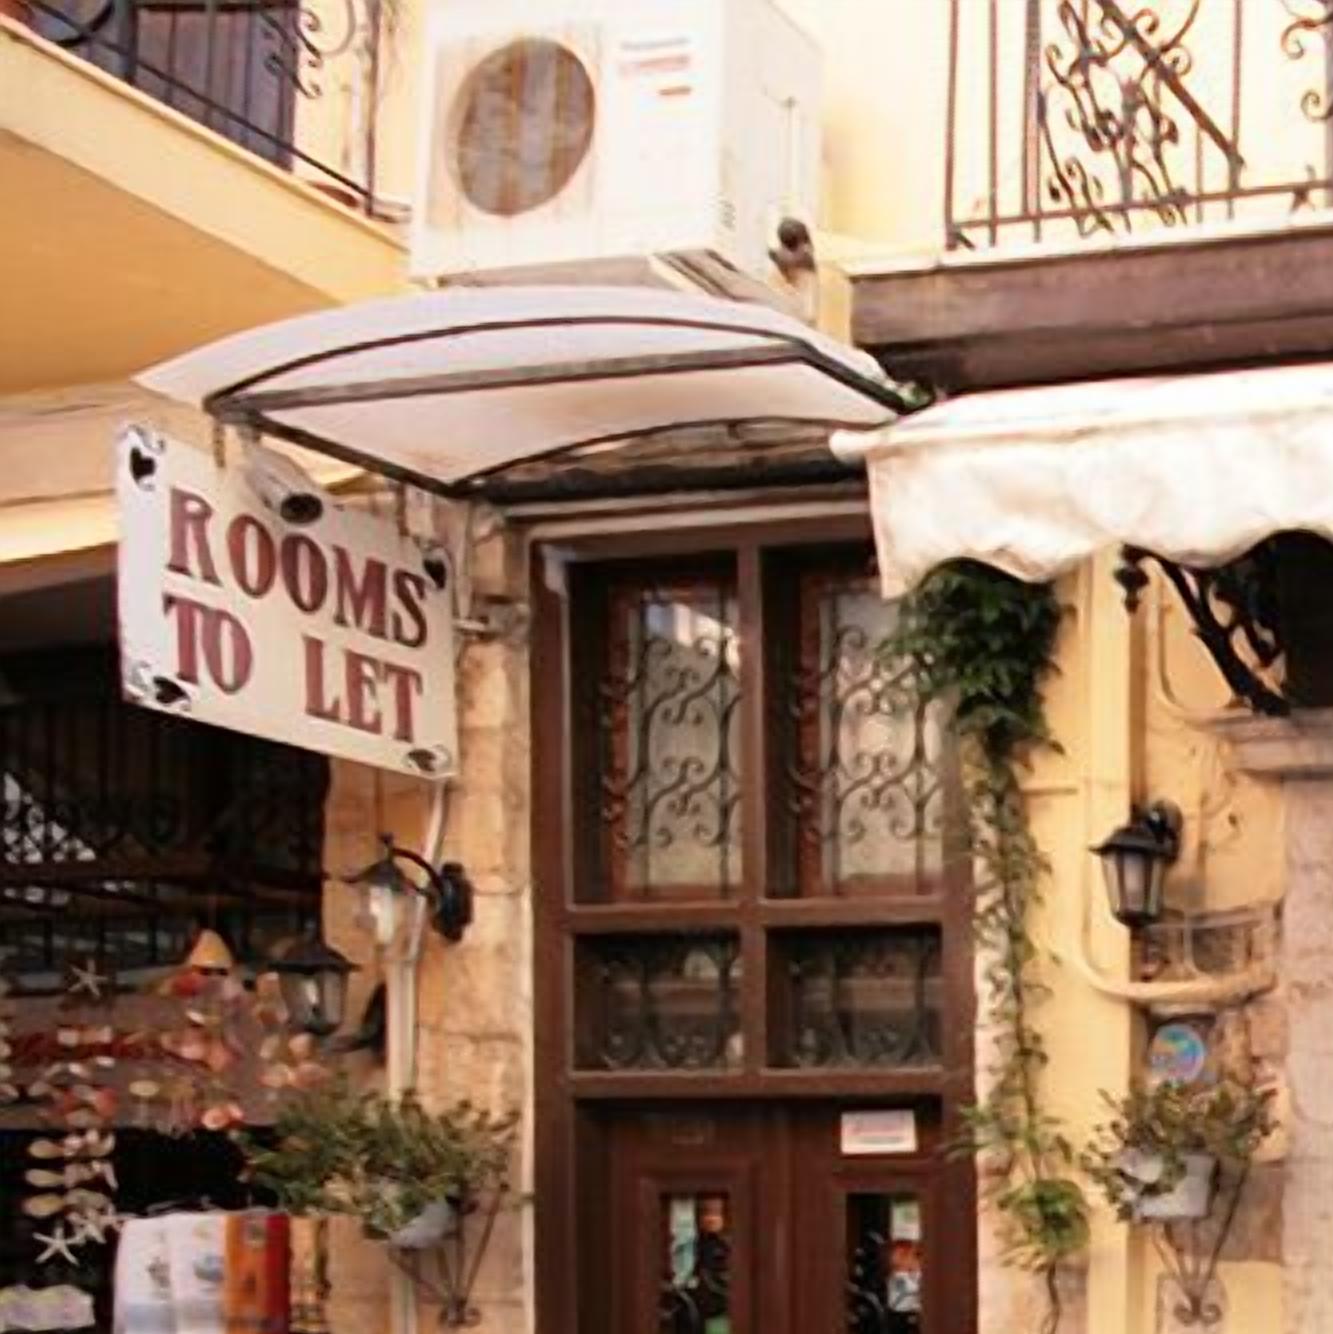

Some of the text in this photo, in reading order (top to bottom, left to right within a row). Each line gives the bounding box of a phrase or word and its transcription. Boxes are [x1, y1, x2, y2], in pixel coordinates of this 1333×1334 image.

[166, 487, 428, 648] ROOMS
[163, 592, 423, 743] TO LET
